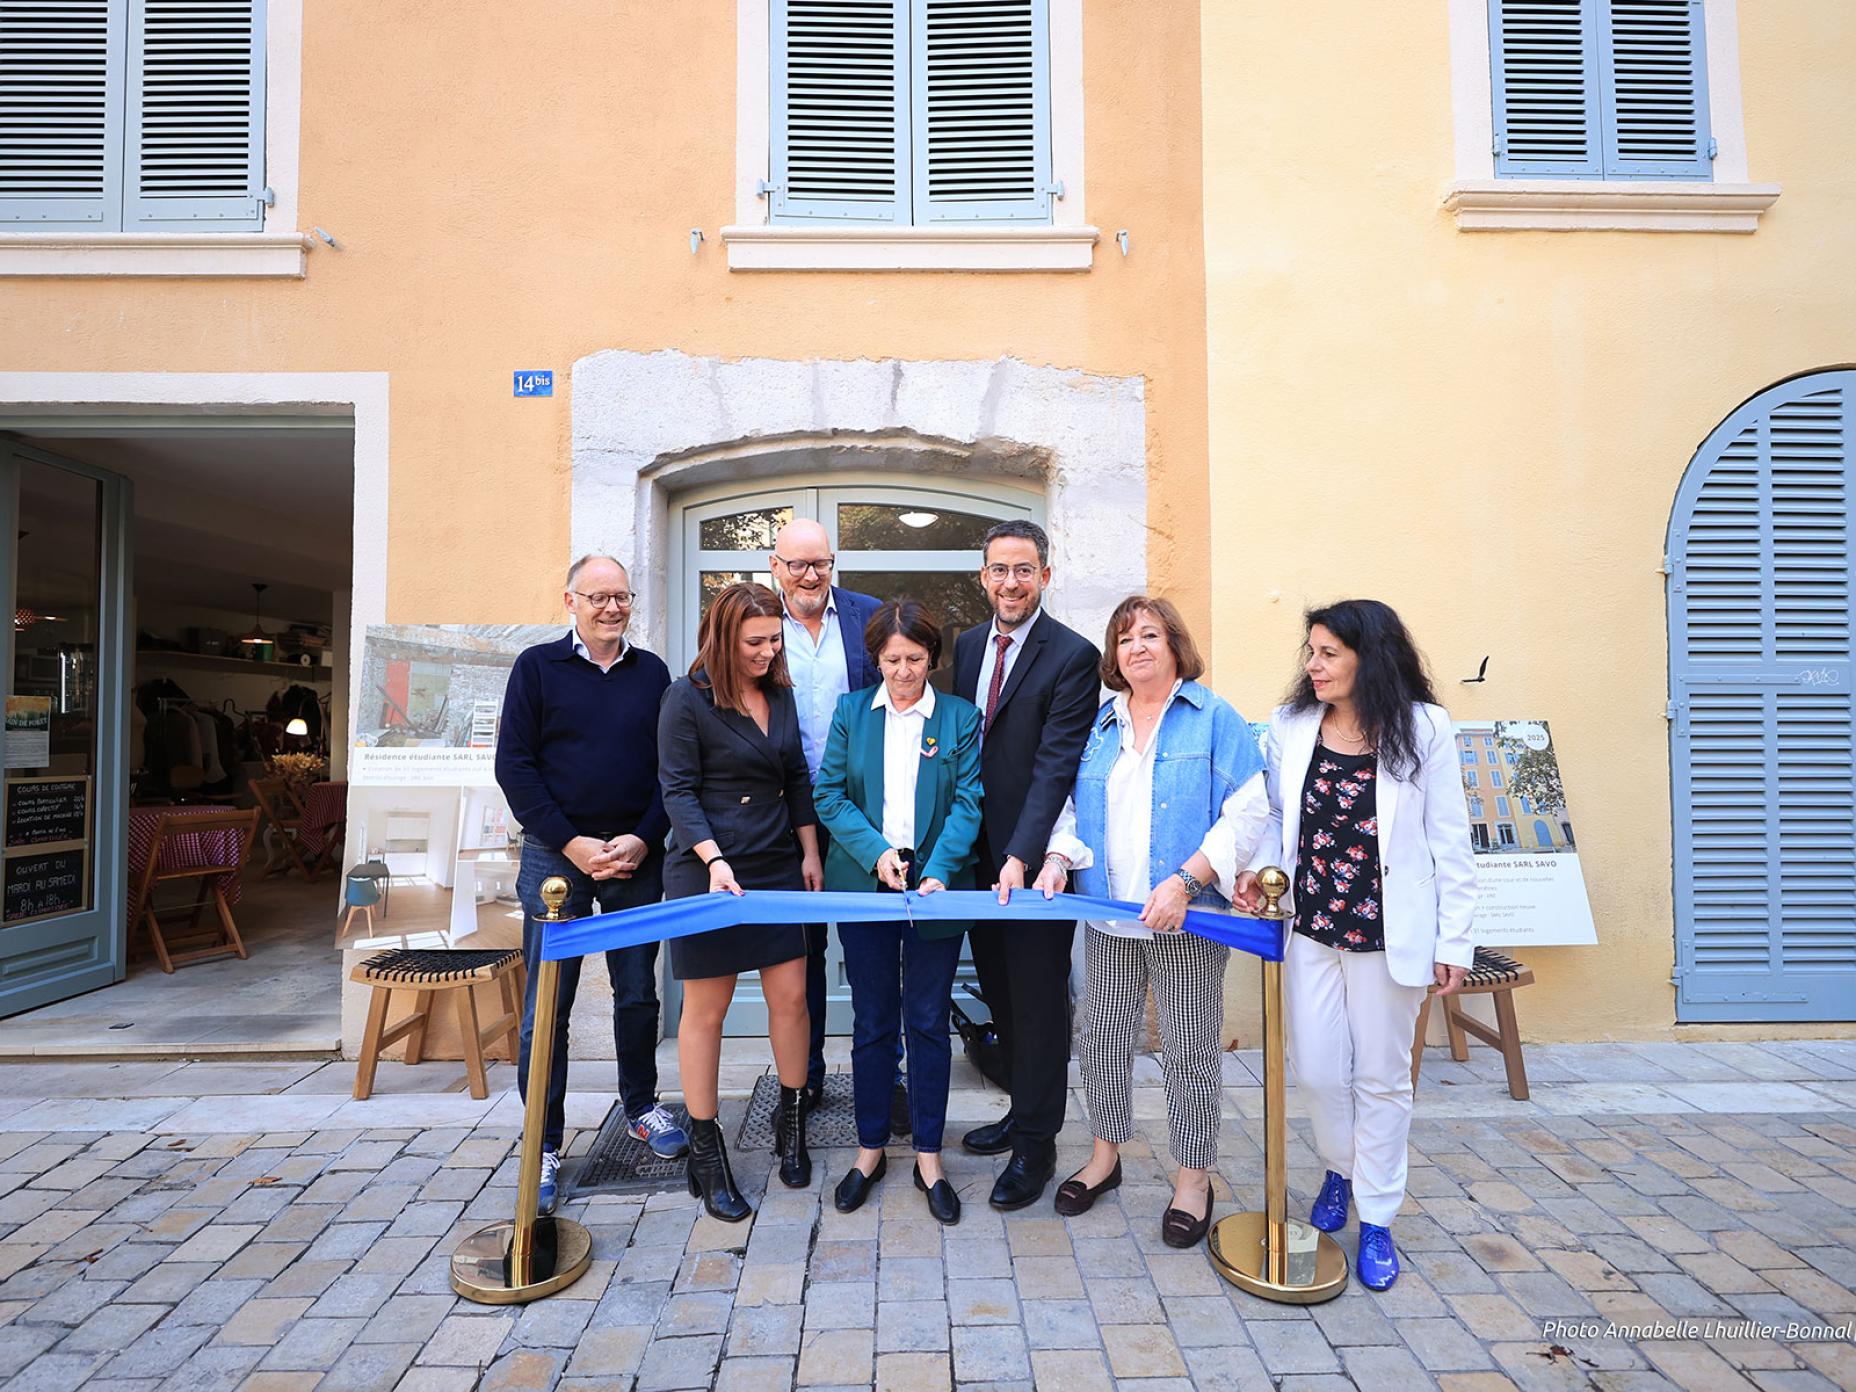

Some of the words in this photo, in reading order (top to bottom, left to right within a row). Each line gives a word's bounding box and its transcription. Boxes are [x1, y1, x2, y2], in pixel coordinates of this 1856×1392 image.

[364, 752, 406, 761] Résidence
[409, 752, 451, 761] étudiante
[453, 753, 473, 761] SARL
[16, 862, 49, 875] OUVERT
[1476, 860, 1511, 868] tudiante
[1513, 860, 1533, 868] SARL
[1535, 860, 1557, 868] SAVO
[35, 879, 46, 890] AU
